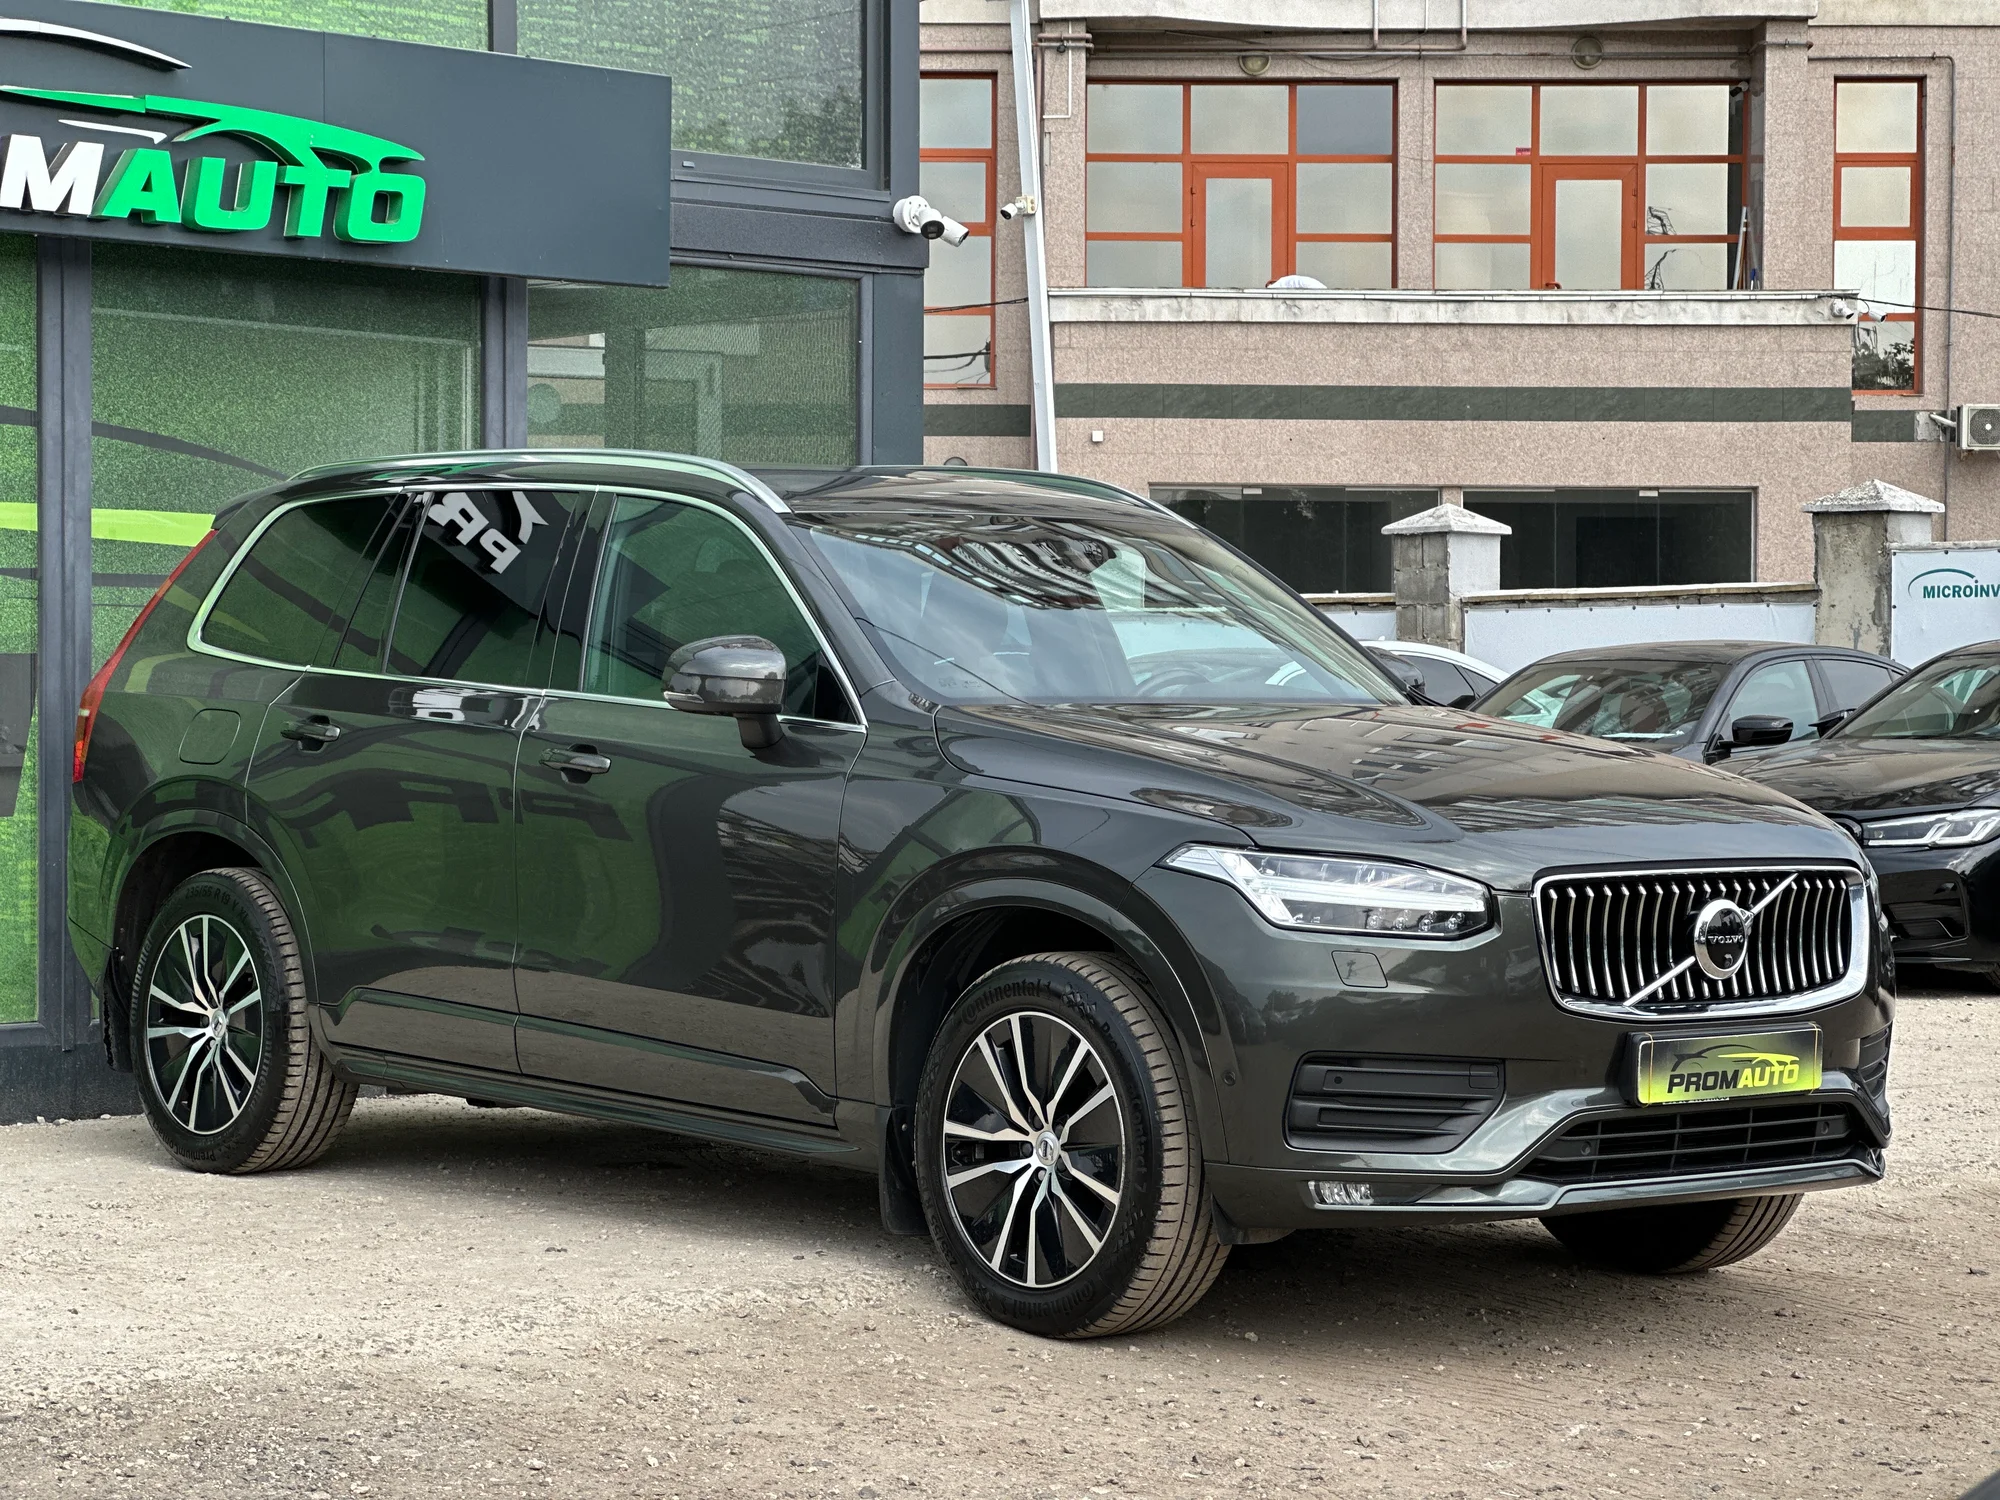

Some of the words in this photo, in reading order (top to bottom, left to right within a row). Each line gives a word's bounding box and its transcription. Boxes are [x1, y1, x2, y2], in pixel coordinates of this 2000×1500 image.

[1708, 935, 1744, 945] VOLVO
[961, 978, 1041, 1025] Continental
[1667, 1064, 1799, 1094] PROMAUTO
